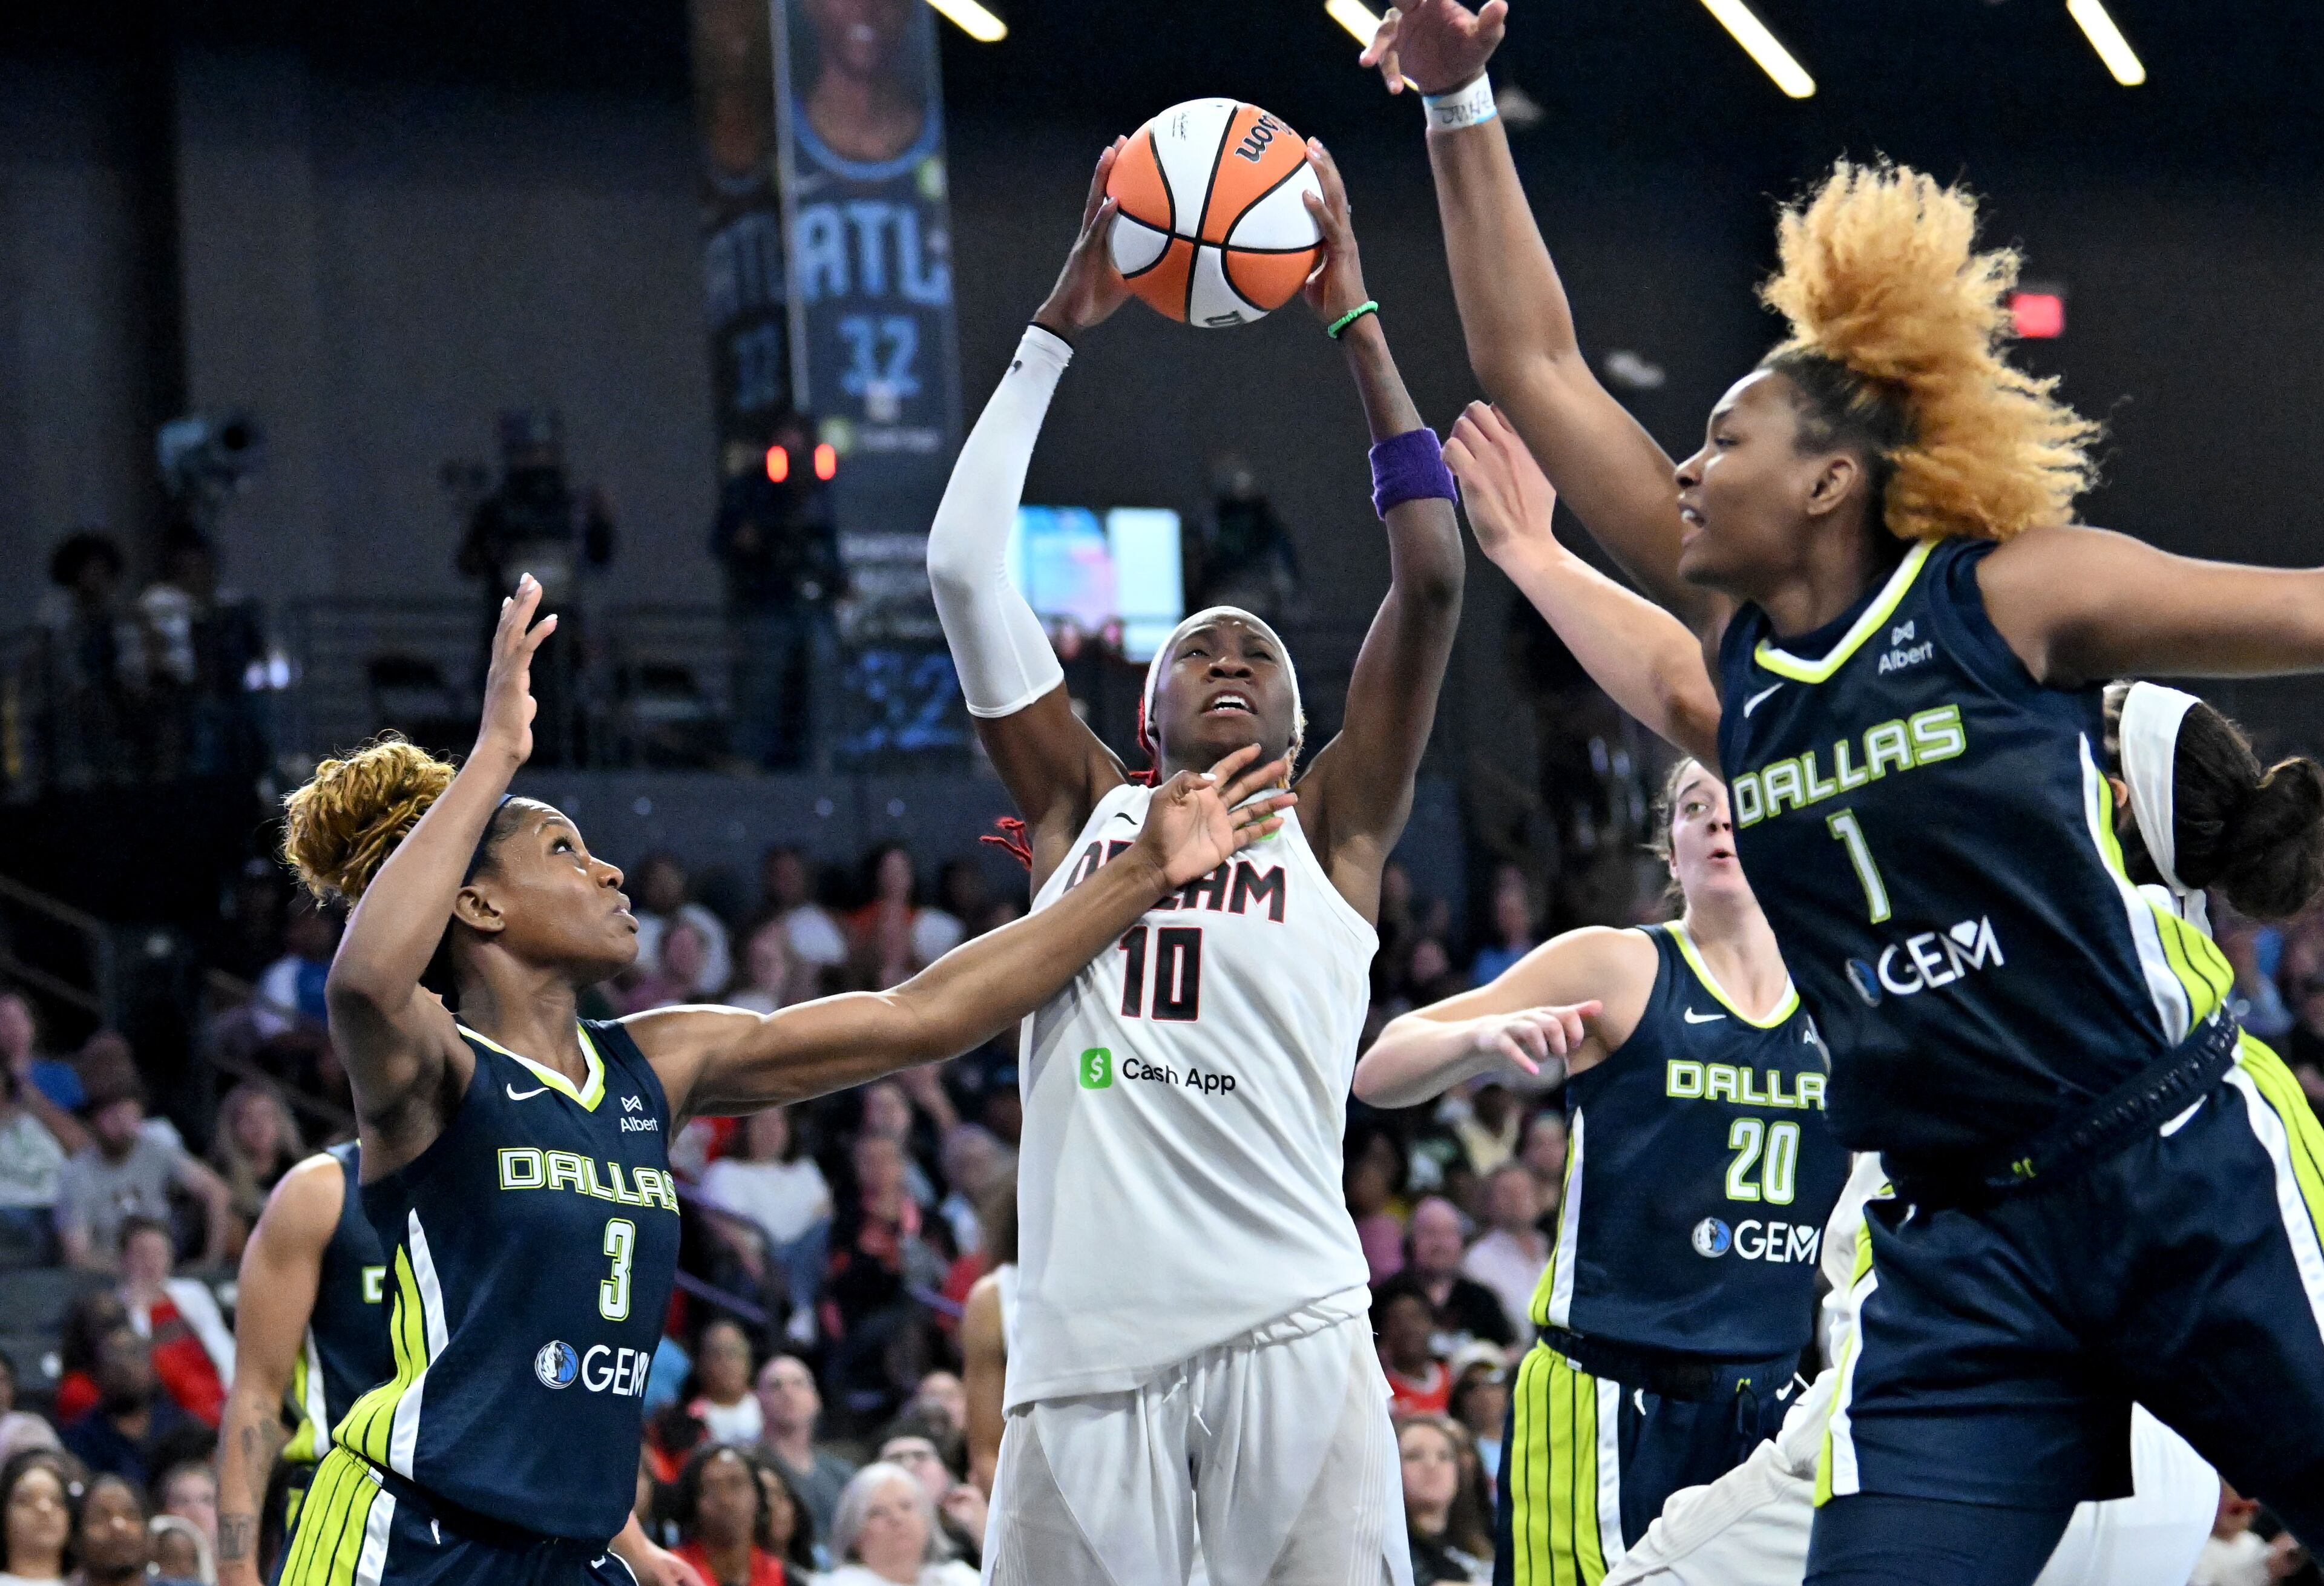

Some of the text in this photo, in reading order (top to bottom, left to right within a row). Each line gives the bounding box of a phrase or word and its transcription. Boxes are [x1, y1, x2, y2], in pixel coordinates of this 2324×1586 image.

[793, 200, 954, 304] ATL
[1878, 640, 1934, 676] Albert
[1732, 703, 1966, 829] DALLAS
[1825, 808, 1891, 925] 1
[1117, 924, 1204, 1023] 10
[1877, 915, 2004, 995] GEM
[1123, 1058, 1178, 1084] Cash
[1185, 1068, 1236, 1095] App
[1666, 1059, 1828, 1110] DALLA
[620, 1116, 658, 1133] Albert
[1725, 1117, 1800, 1205] 20
[599, 1217, 635, 1321] 3
[1734, 1219, 1820, 1265] GEM
[582, 1344, 651, 1398] GEM
